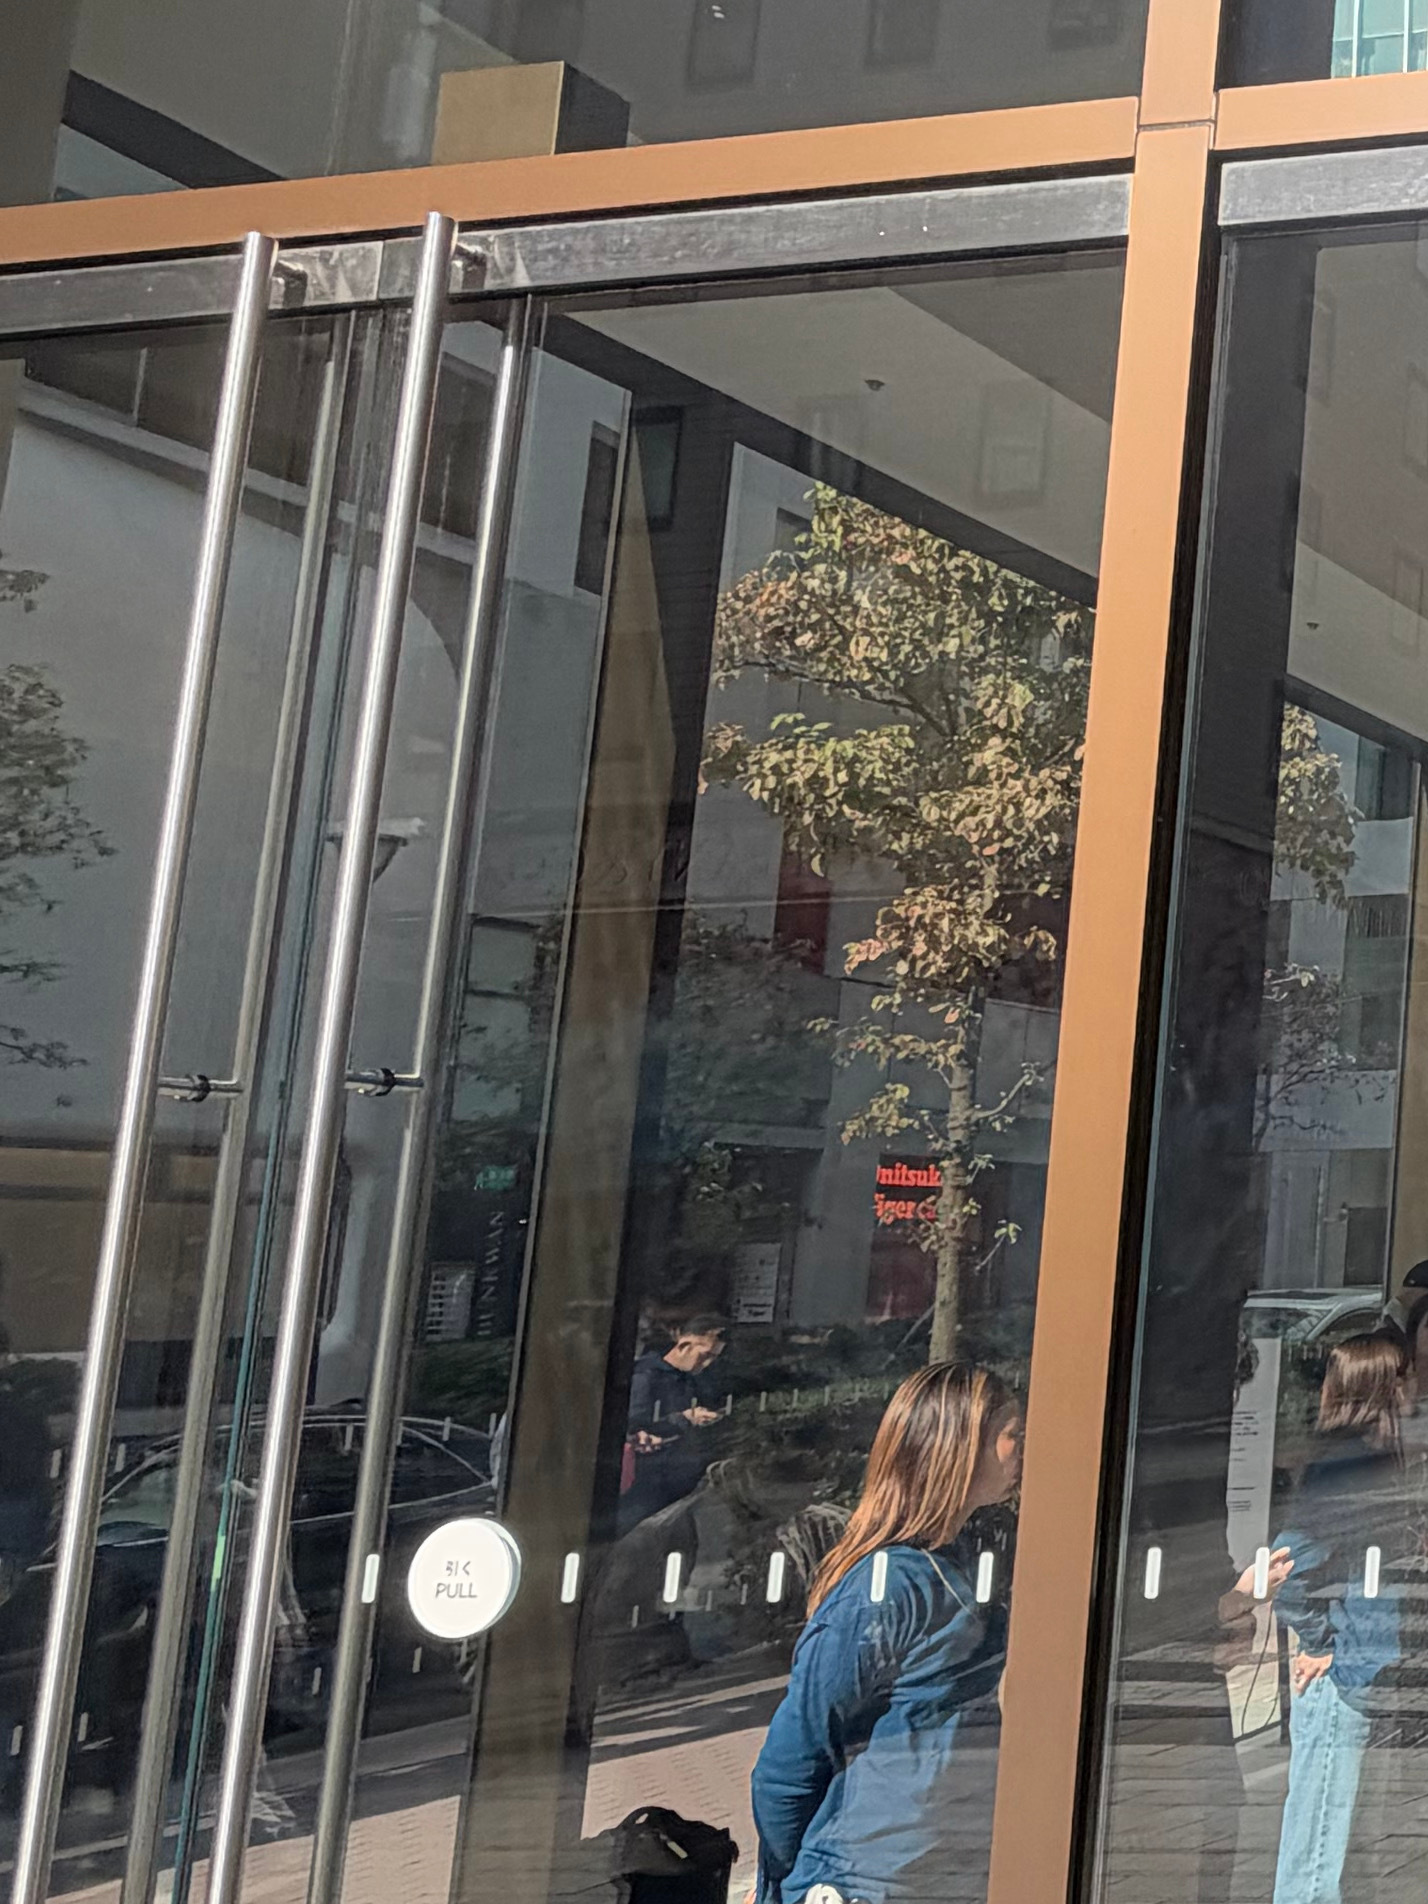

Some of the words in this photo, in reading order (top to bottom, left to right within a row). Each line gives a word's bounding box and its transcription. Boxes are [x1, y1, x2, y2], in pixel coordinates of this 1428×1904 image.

[876, 1162, 942, 1187] nitsuk
[874, 1193, 917, 1225] iger
[445, 1560, 471, 1577] 引く
[435, 1582, 478, 1598] PULL
